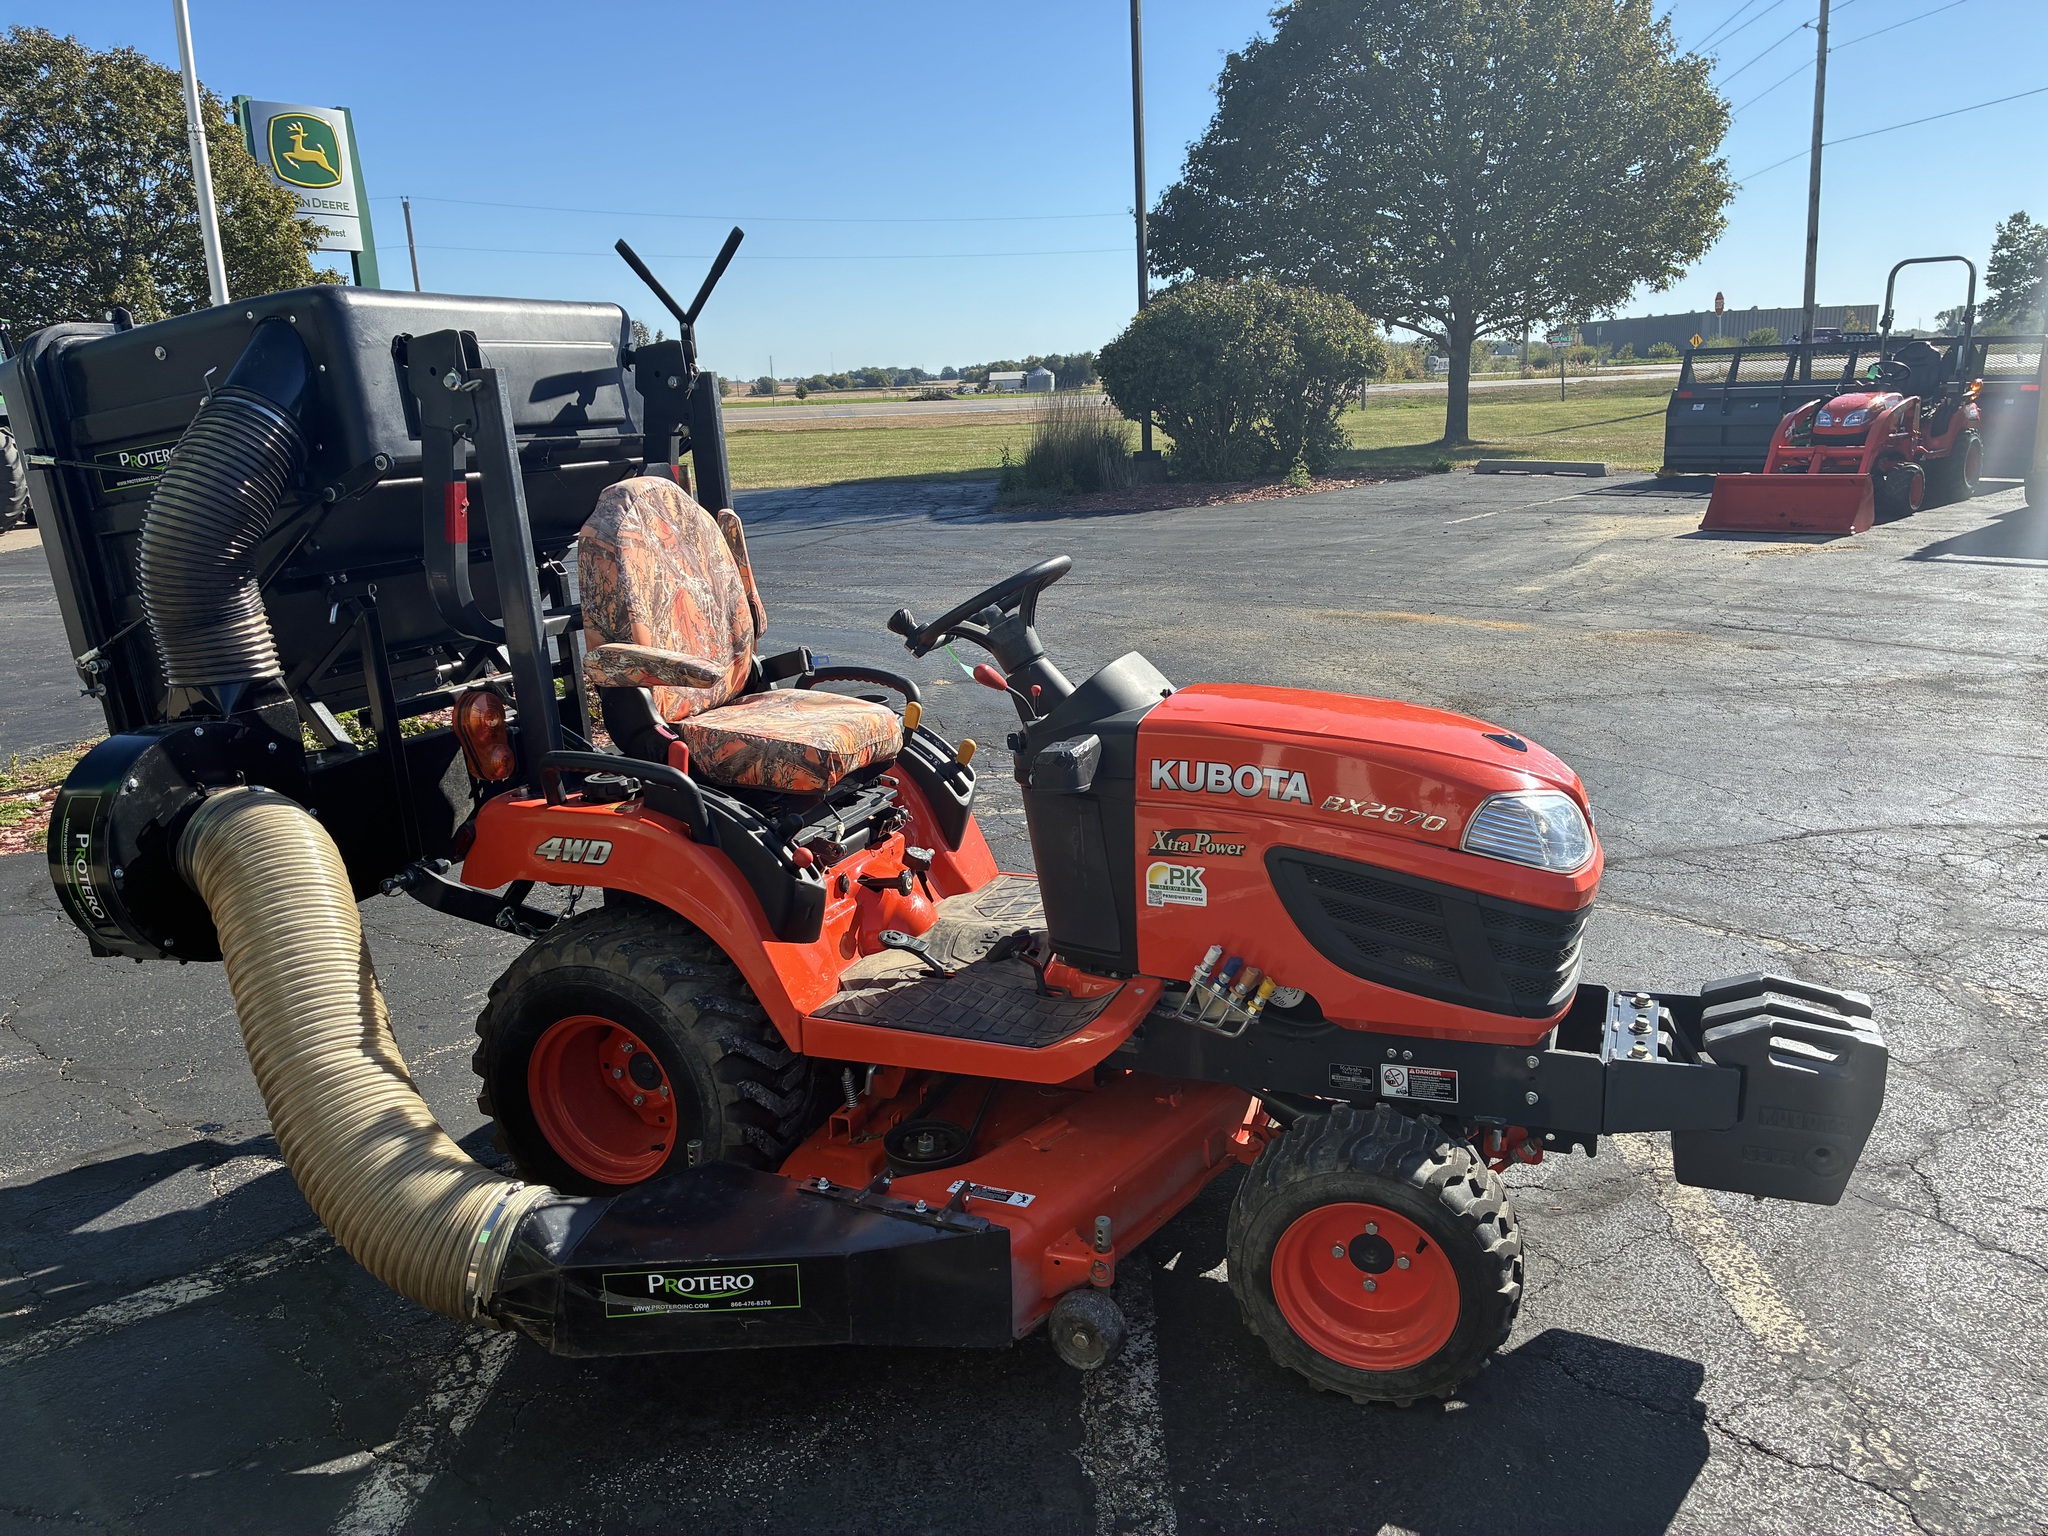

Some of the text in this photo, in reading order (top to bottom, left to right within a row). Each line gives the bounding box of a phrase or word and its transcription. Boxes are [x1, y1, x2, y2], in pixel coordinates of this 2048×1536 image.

[312, 198, 350, 211] DEERE
[1150, 759, 1313, 806] KUBOTA
[1320, 795, 1448, 832] BX2670
[534, 836, 614, 865] 4WD
[1149, 830, 1246, 856] Xtra Power
[75, 833, 105, 919] PROTERO
[1163, 893, 1203, 905] PKMIDWEST.COM
[1415, 1068, 1442, 1076] DANGER
[647, 1274, 755, 1296] PROTERO
[632, 1303, 709, 1312] WWW.PROTEROINC.COM
